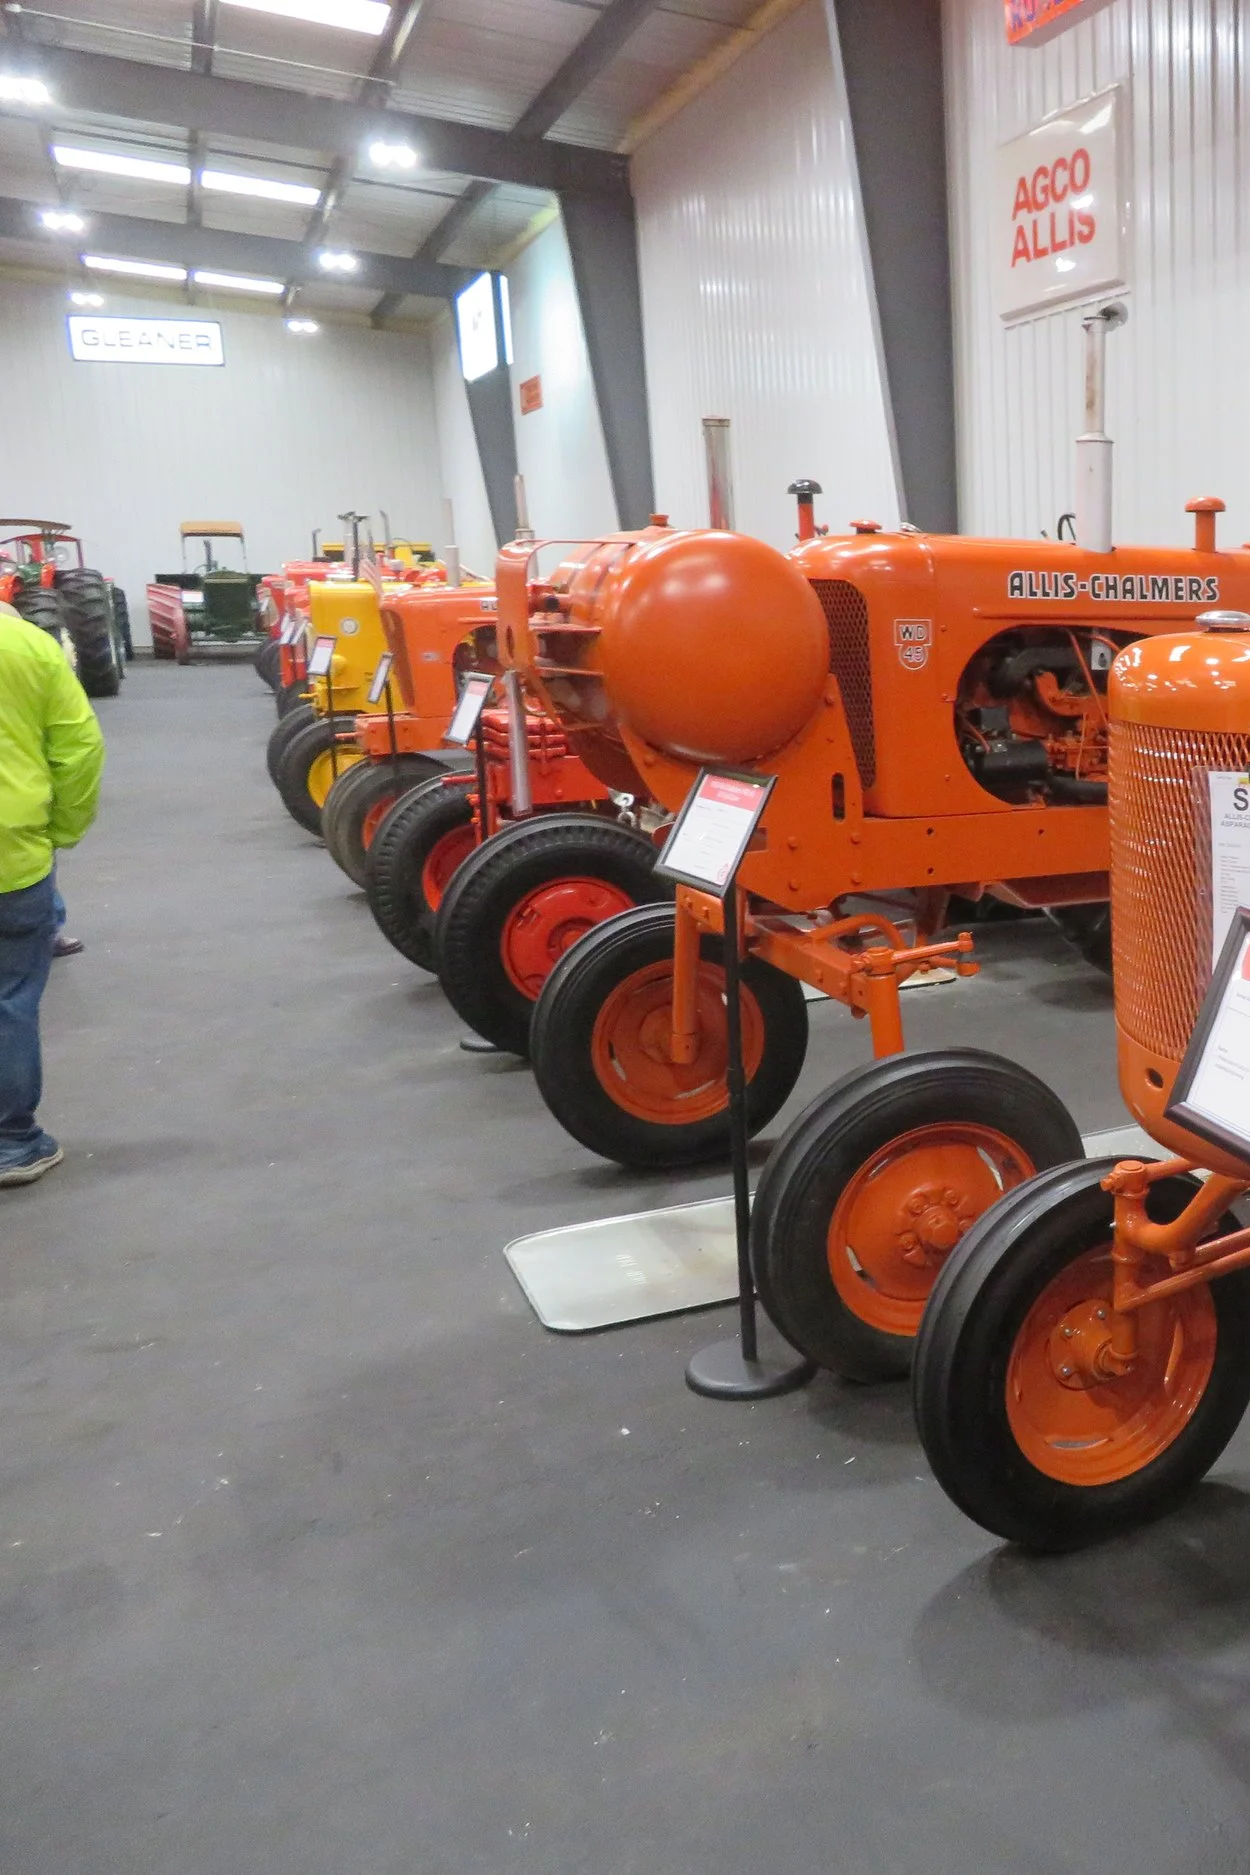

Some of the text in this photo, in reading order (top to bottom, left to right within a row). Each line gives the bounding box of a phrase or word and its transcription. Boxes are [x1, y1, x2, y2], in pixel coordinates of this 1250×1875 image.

[1011, 148, 1091, 221] AGCO
[1010, 209, 1096, 268] ALLIS
[81, 328, 212, 350] GLEANER
[1008, 570, 1220, 602] ALLIS-CHALMERS
[900, 625, 926, 641] WD
[903, 646, 925, 663] 45
